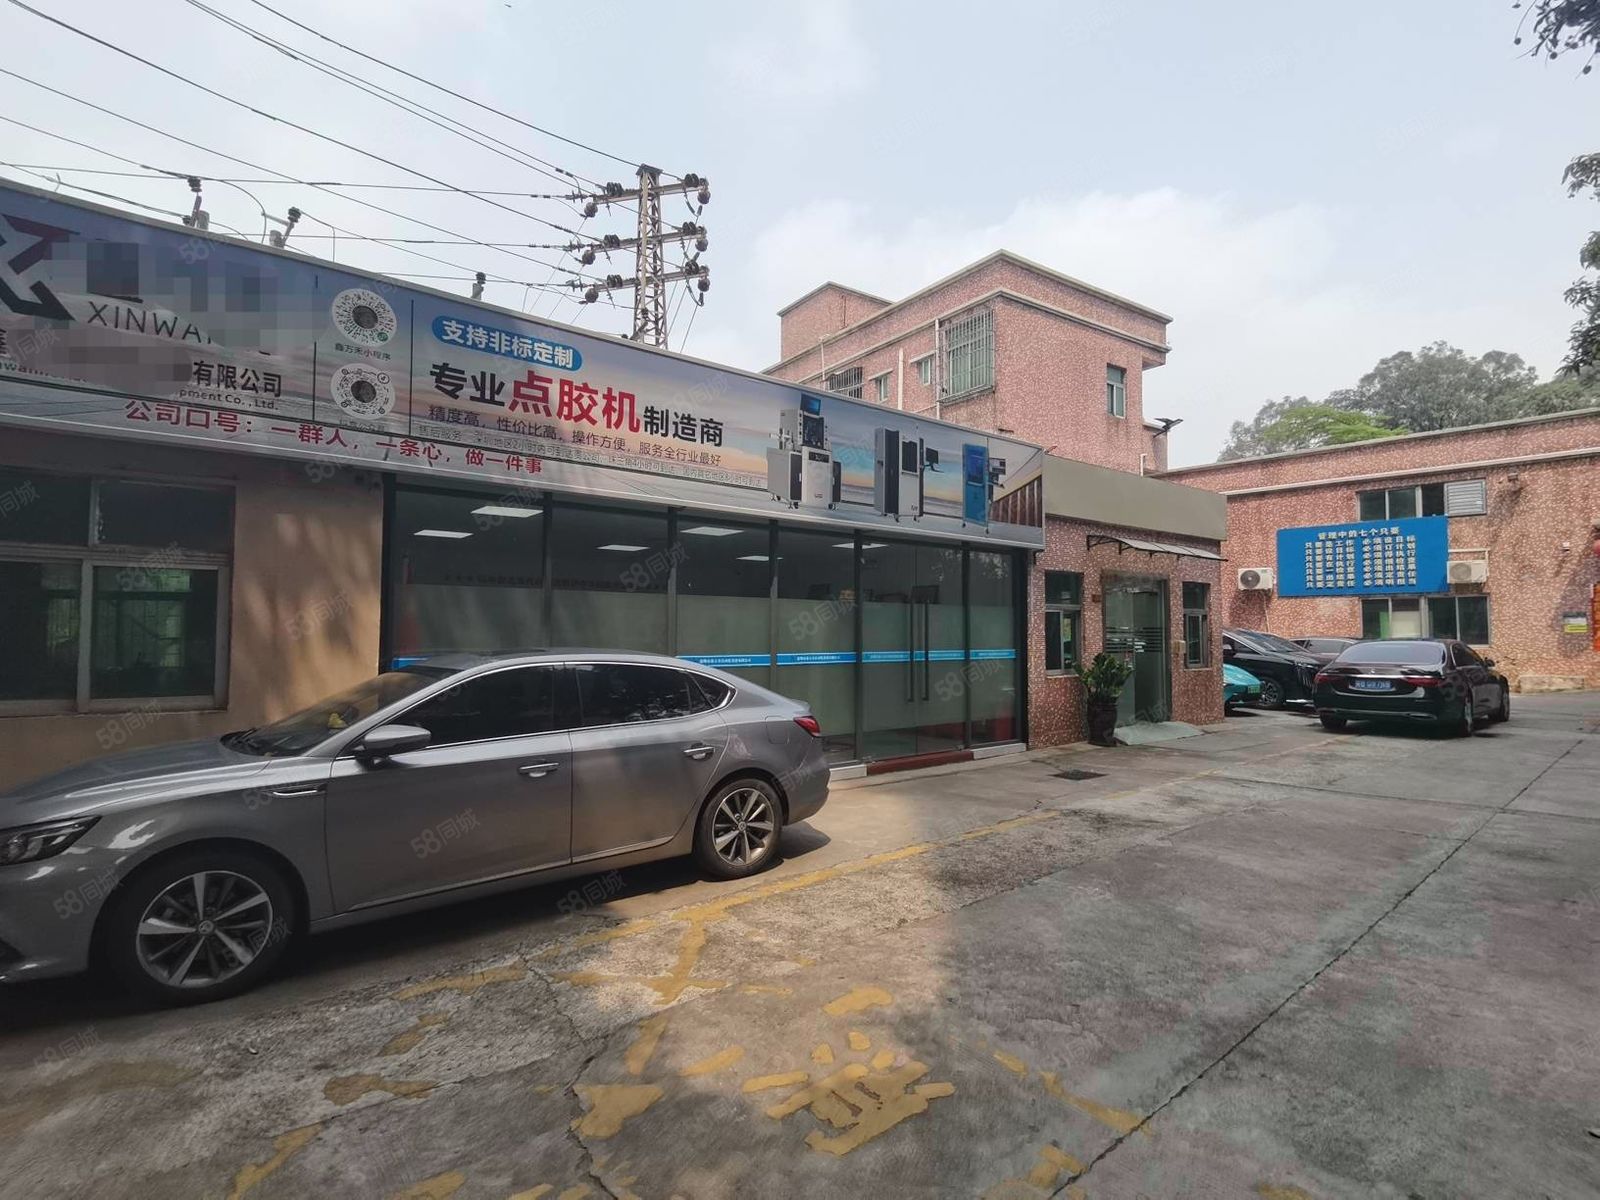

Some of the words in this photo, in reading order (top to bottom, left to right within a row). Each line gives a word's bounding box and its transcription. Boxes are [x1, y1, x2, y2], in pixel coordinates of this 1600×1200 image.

[88, 301, 211, 344] XINWA
[442, 320, 573, 367] 支持非标定制
[193, 361, 281, 397] 有限公司
[430, 362, 723, 447] 专业点胶机制造商
[1318, 526, 1400, 540] 管理中的七个只要
